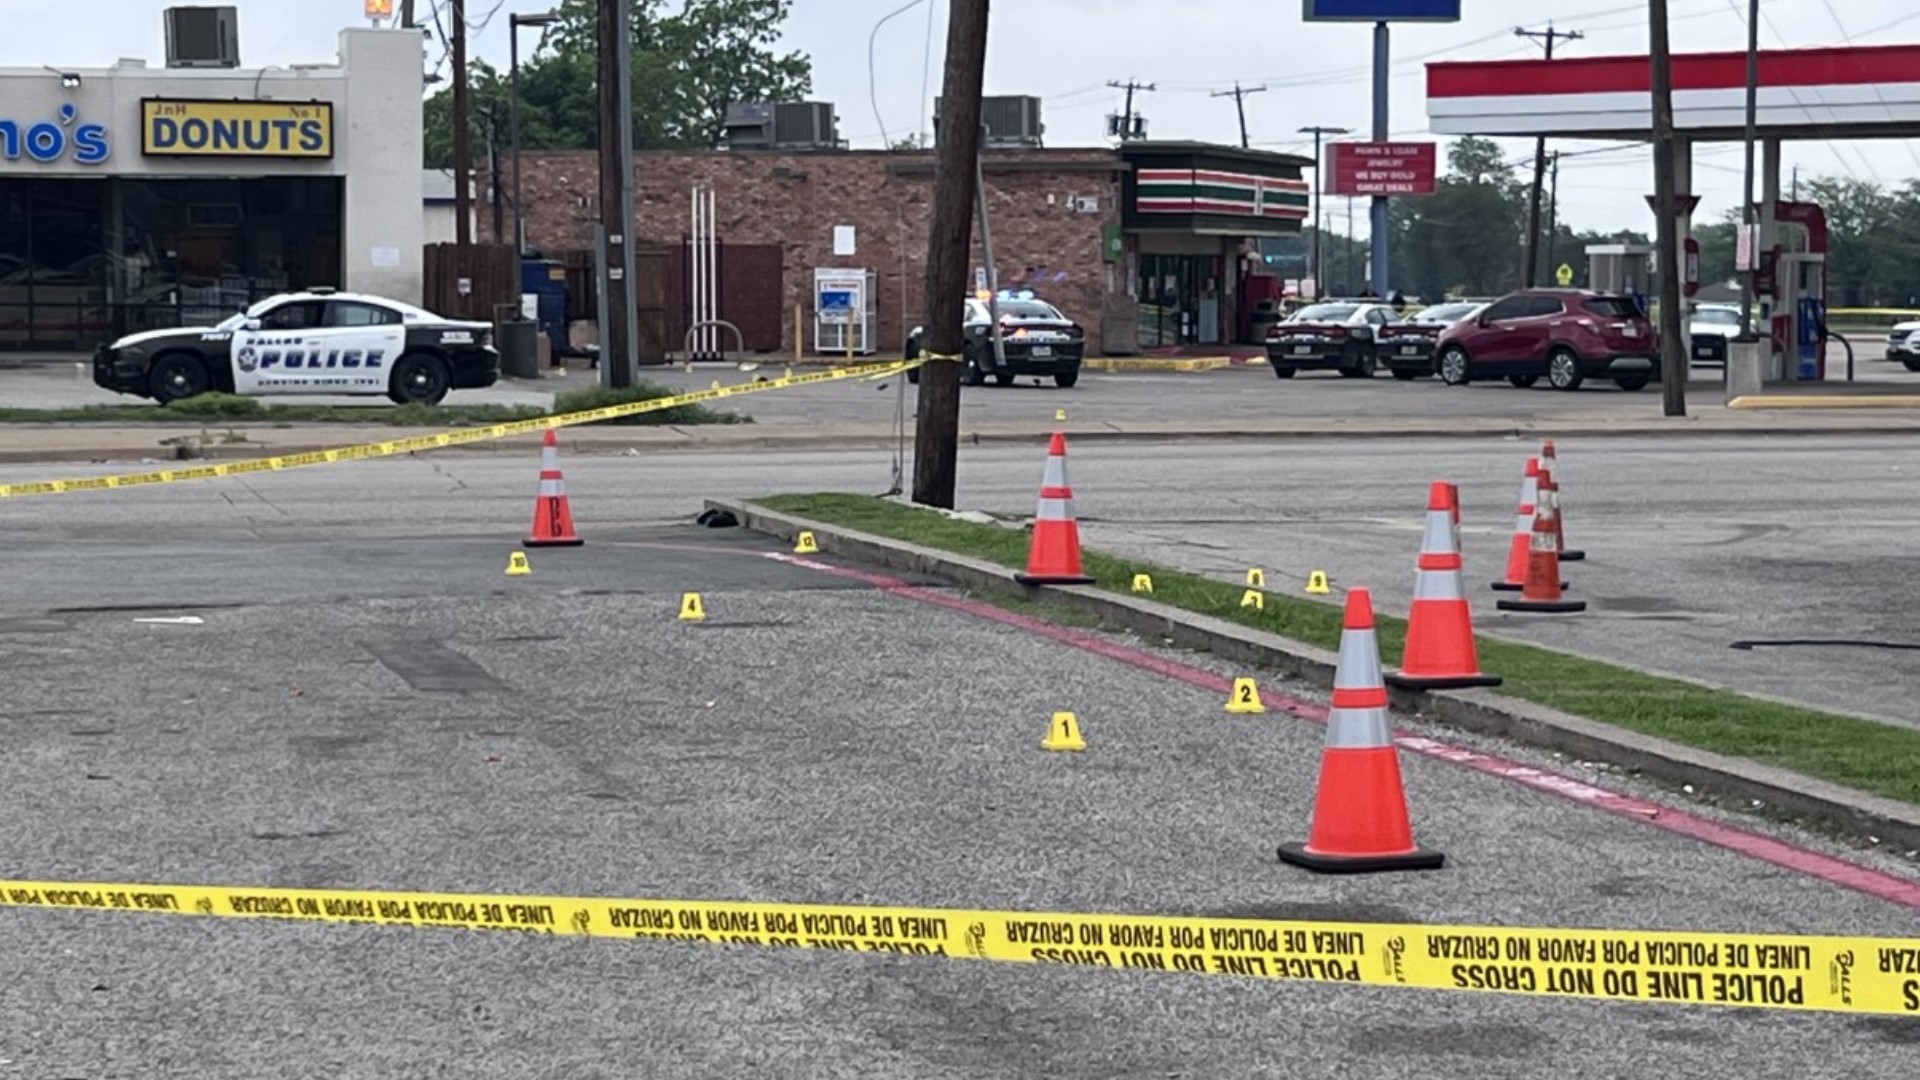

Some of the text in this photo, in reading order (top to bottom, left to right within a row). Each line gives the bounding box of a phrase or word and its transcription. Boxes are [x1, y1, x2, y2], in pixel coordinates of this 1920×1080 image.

[154, 104, 187, 115] JnH
[153, 118, 323, 150] DONUTS
[260, 350, 384, 368] POLICE
[688, 598, 696, 612] 4
[1241, 685, 1251, 702] 2
[1061, 719, 1069, 737] 1
[43, 890, 101, 907] POLICIA
[108, 893, 129, 907] DE
[132, 893, 179, 910] LINEA
[229, 896, 291, 914] CRUZAR
[297, 898, 318, 915] NO
[323, 899, 372, 918] FAVOR
[378, 900, 408, 920] POR
[414, 901, 475, 922] POLICIA
[481, 904, 502, 922] DE
[506, 904, 554, 925] LINEA
[610, 908, 670, 929] CRUZAR
[679, 910, 700, 929] NO
[707, 910, 758, 931] FAVOR
[763, 912, 797, 932] POR
[803, 914, 865, 935] POLICIA
[872, 916, 893, 938] DE
[899, 917, 948, 940] LINEA
[1006, 921, 1073, 943] CRUZAR
[1080, 923, 1101, 945] NO
[1110, 924, 1163, 946] FAVOR
[1170, 926, 1204, 948] POR
[1211, 928, 1278, 951] POLICIA
[1284, 931, 1306, 952] DE
[1313, 932, 1364, 955] LINEA
[1173, 954, 1203, 971] DO
[1428, 935, 1810, 969] LINEA DE POLICIA POR FAVOR NO CRUZAR
[1213, 955, 1266, 976] LINE
[1274, 958, 1360, 981] POLICE
[1452, 965, 1536, 991] CROSS
[1547, 968, 1593, 995] NOT
[1604, 970, 1638, 996] DO
[1648, 972, 1703, 1000] LINE
[1713, 974, 1803, 1004] POLICE
